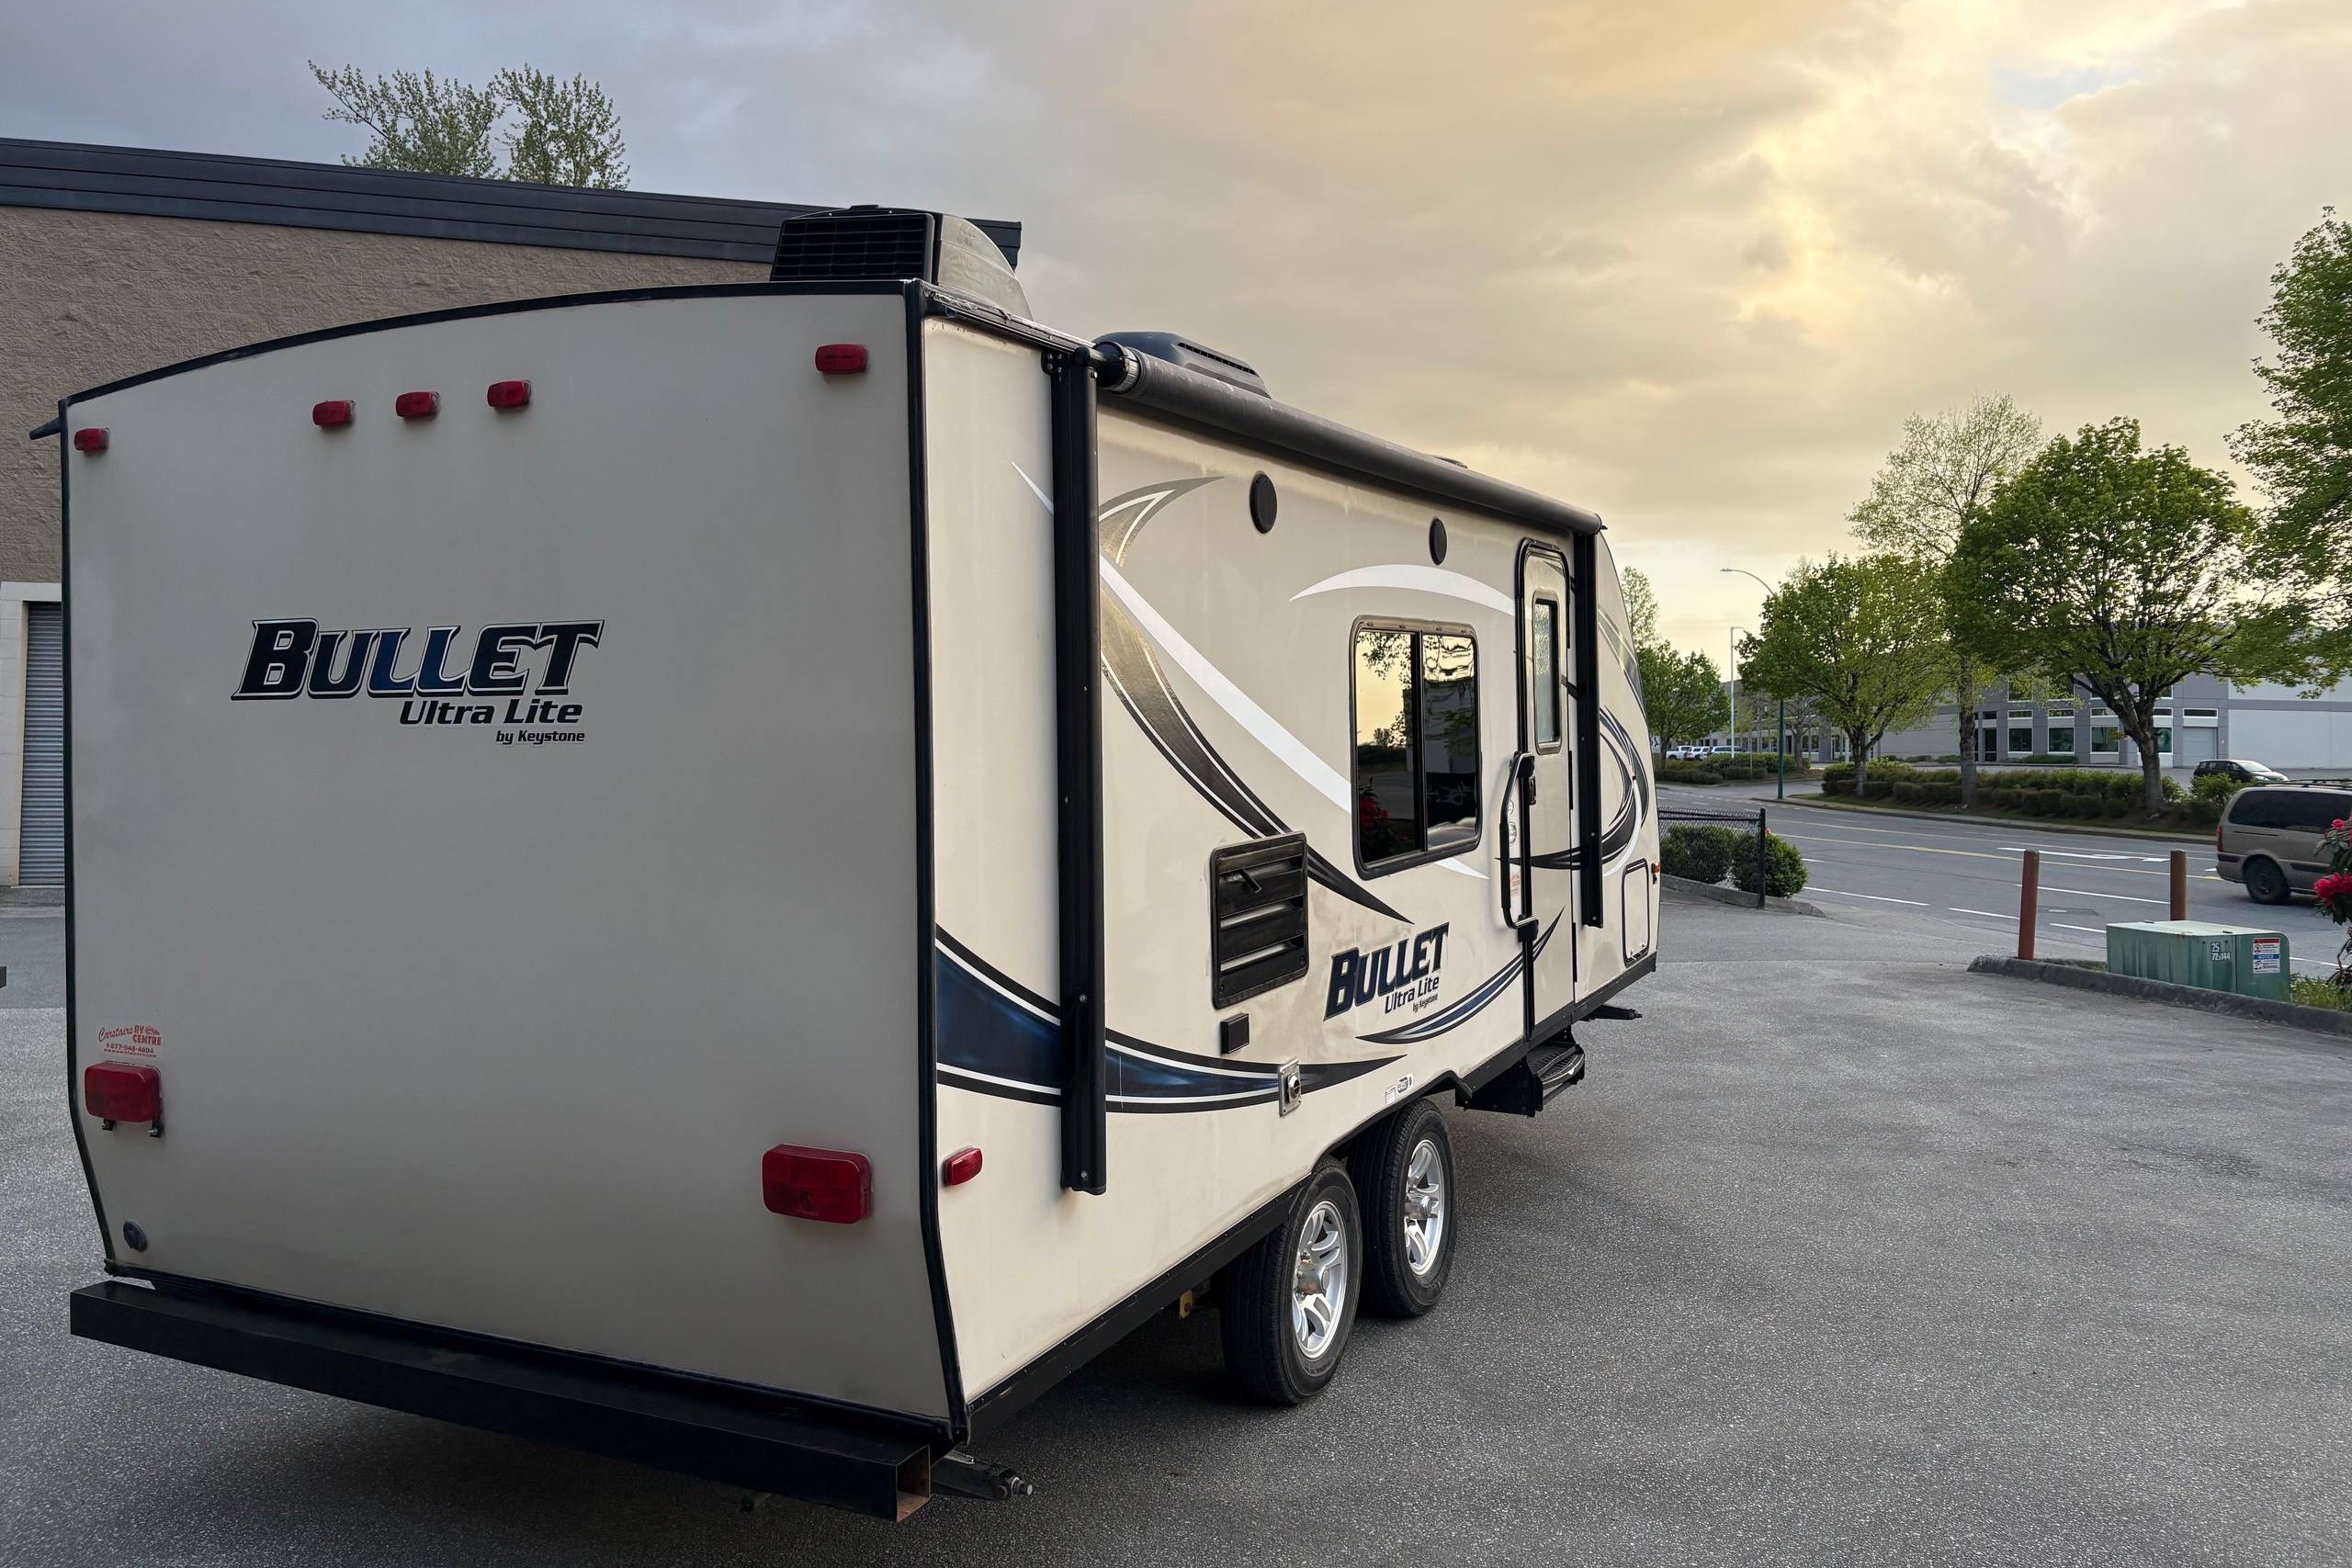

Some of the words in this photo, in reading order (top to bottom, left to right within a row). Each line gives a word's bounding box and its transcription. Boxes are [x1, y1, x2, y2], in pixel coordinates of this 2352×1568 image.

[231, 617, 605, 701] BULLET
[400, 700, 494, 725] Ultra
[503, 699, 582, 724] Lite
[495, 730, 514, 745] by
[517, 729, 585, 745] Keystone
[2211, 942, 2220, 953] 25
[1323, 921, 1449, 1021] BULLET
[1385, 987, 1415, 1014] Ultra
[1418, 976, 1440, 998] Lite
[1412, 1002, 1419, 1012] by
[134, 1024, 144, 1034] RV
[133, 1034, 162, 1045] CENTRE
